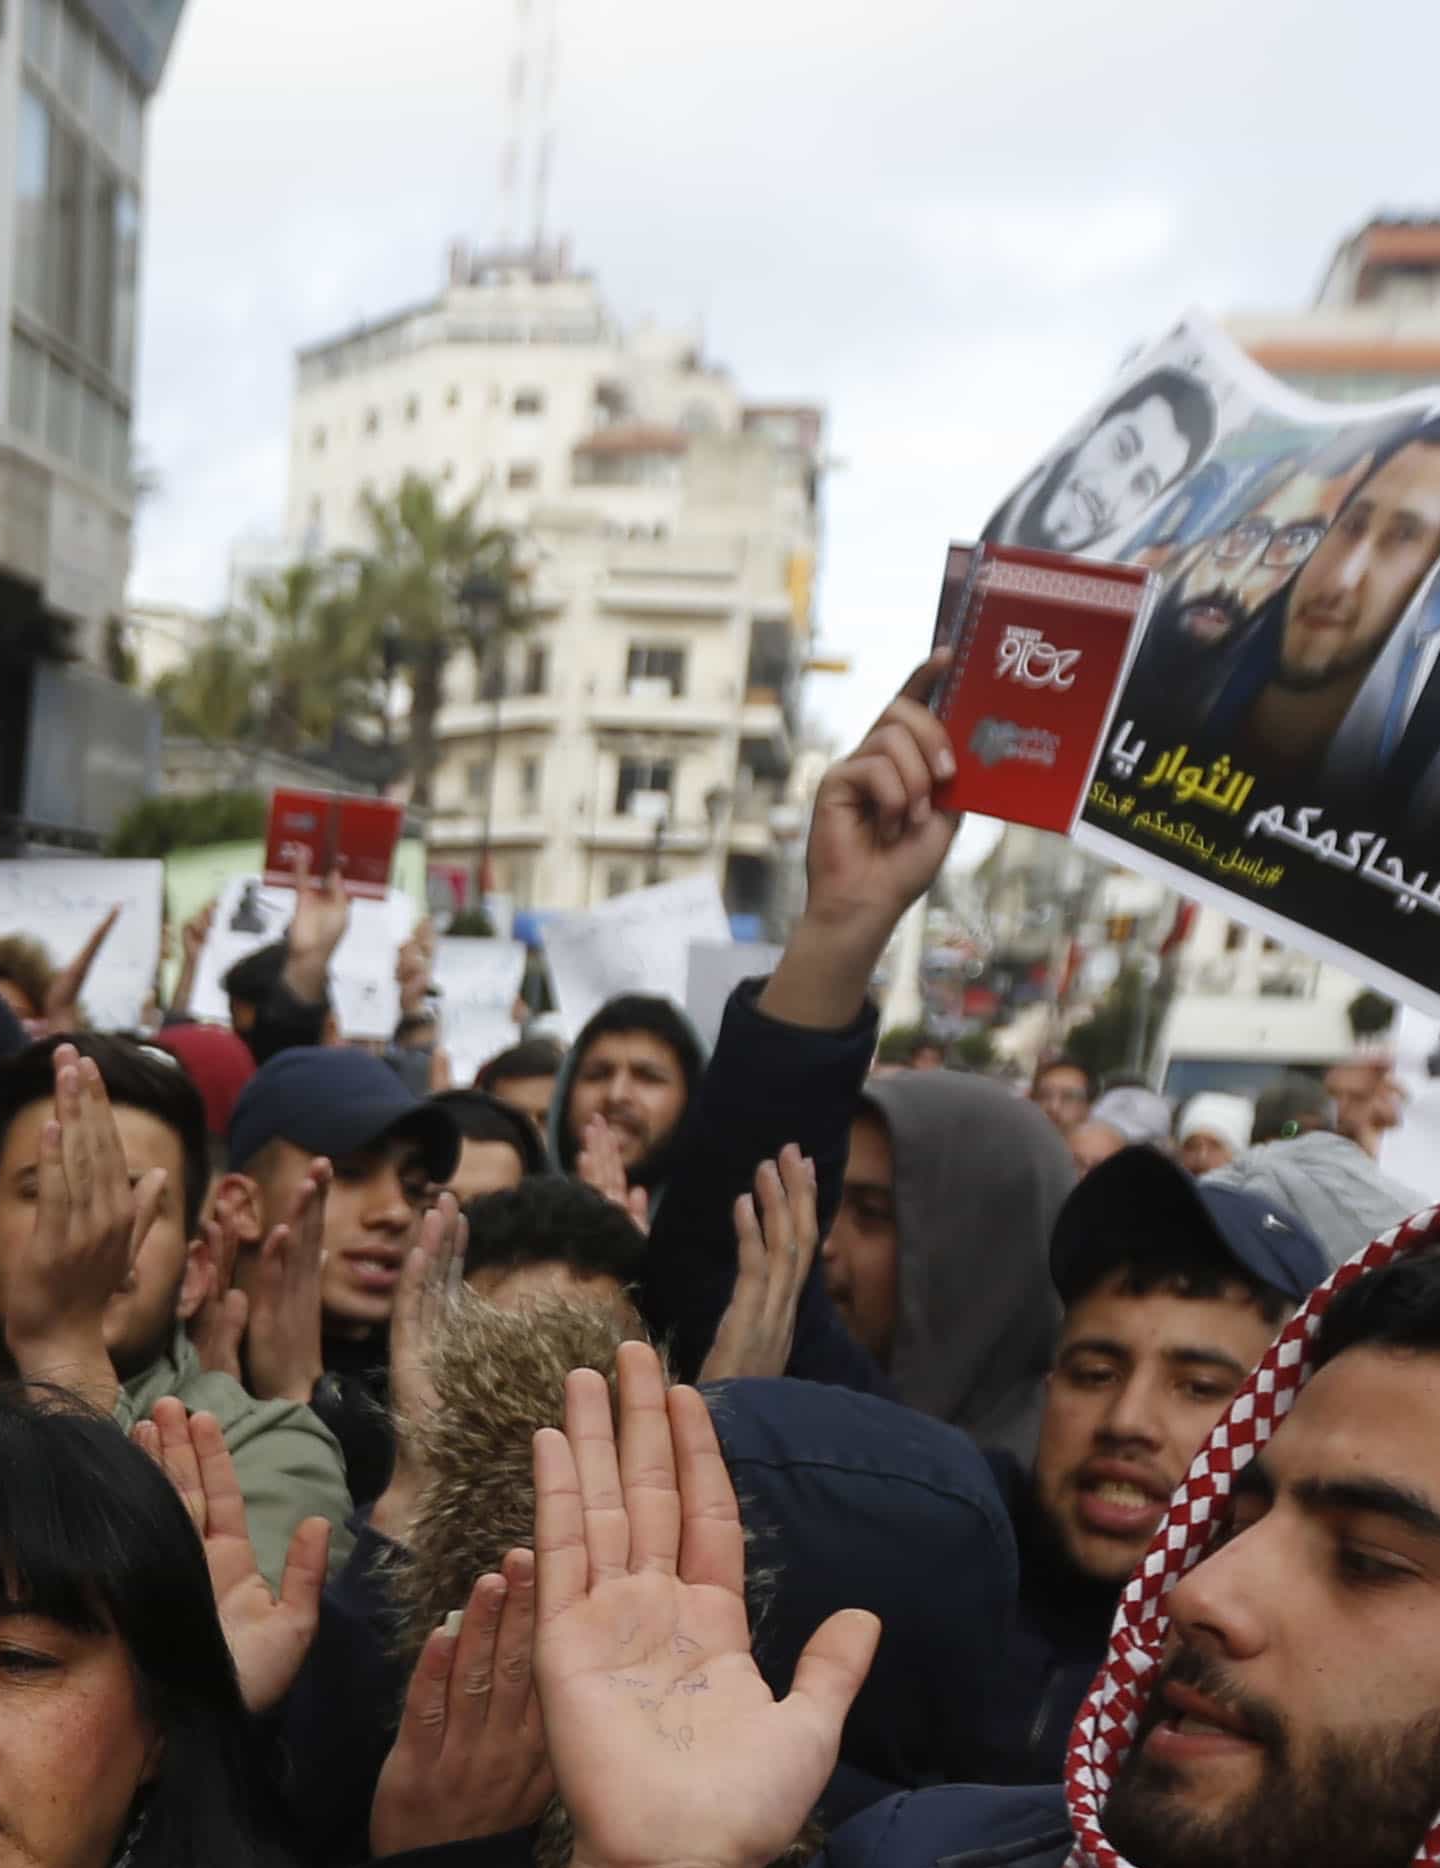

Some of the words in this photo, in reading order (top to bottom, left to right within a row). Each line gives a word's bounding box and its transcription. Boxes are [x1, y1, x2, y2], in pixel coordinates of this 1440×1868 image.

[995, 636, 1083, 687] 2016
[1107, 718, 1148, 779] يا
[1087, 779, 1138, 818] #حاك
[1142, 744, 1257, 816] الثوار
